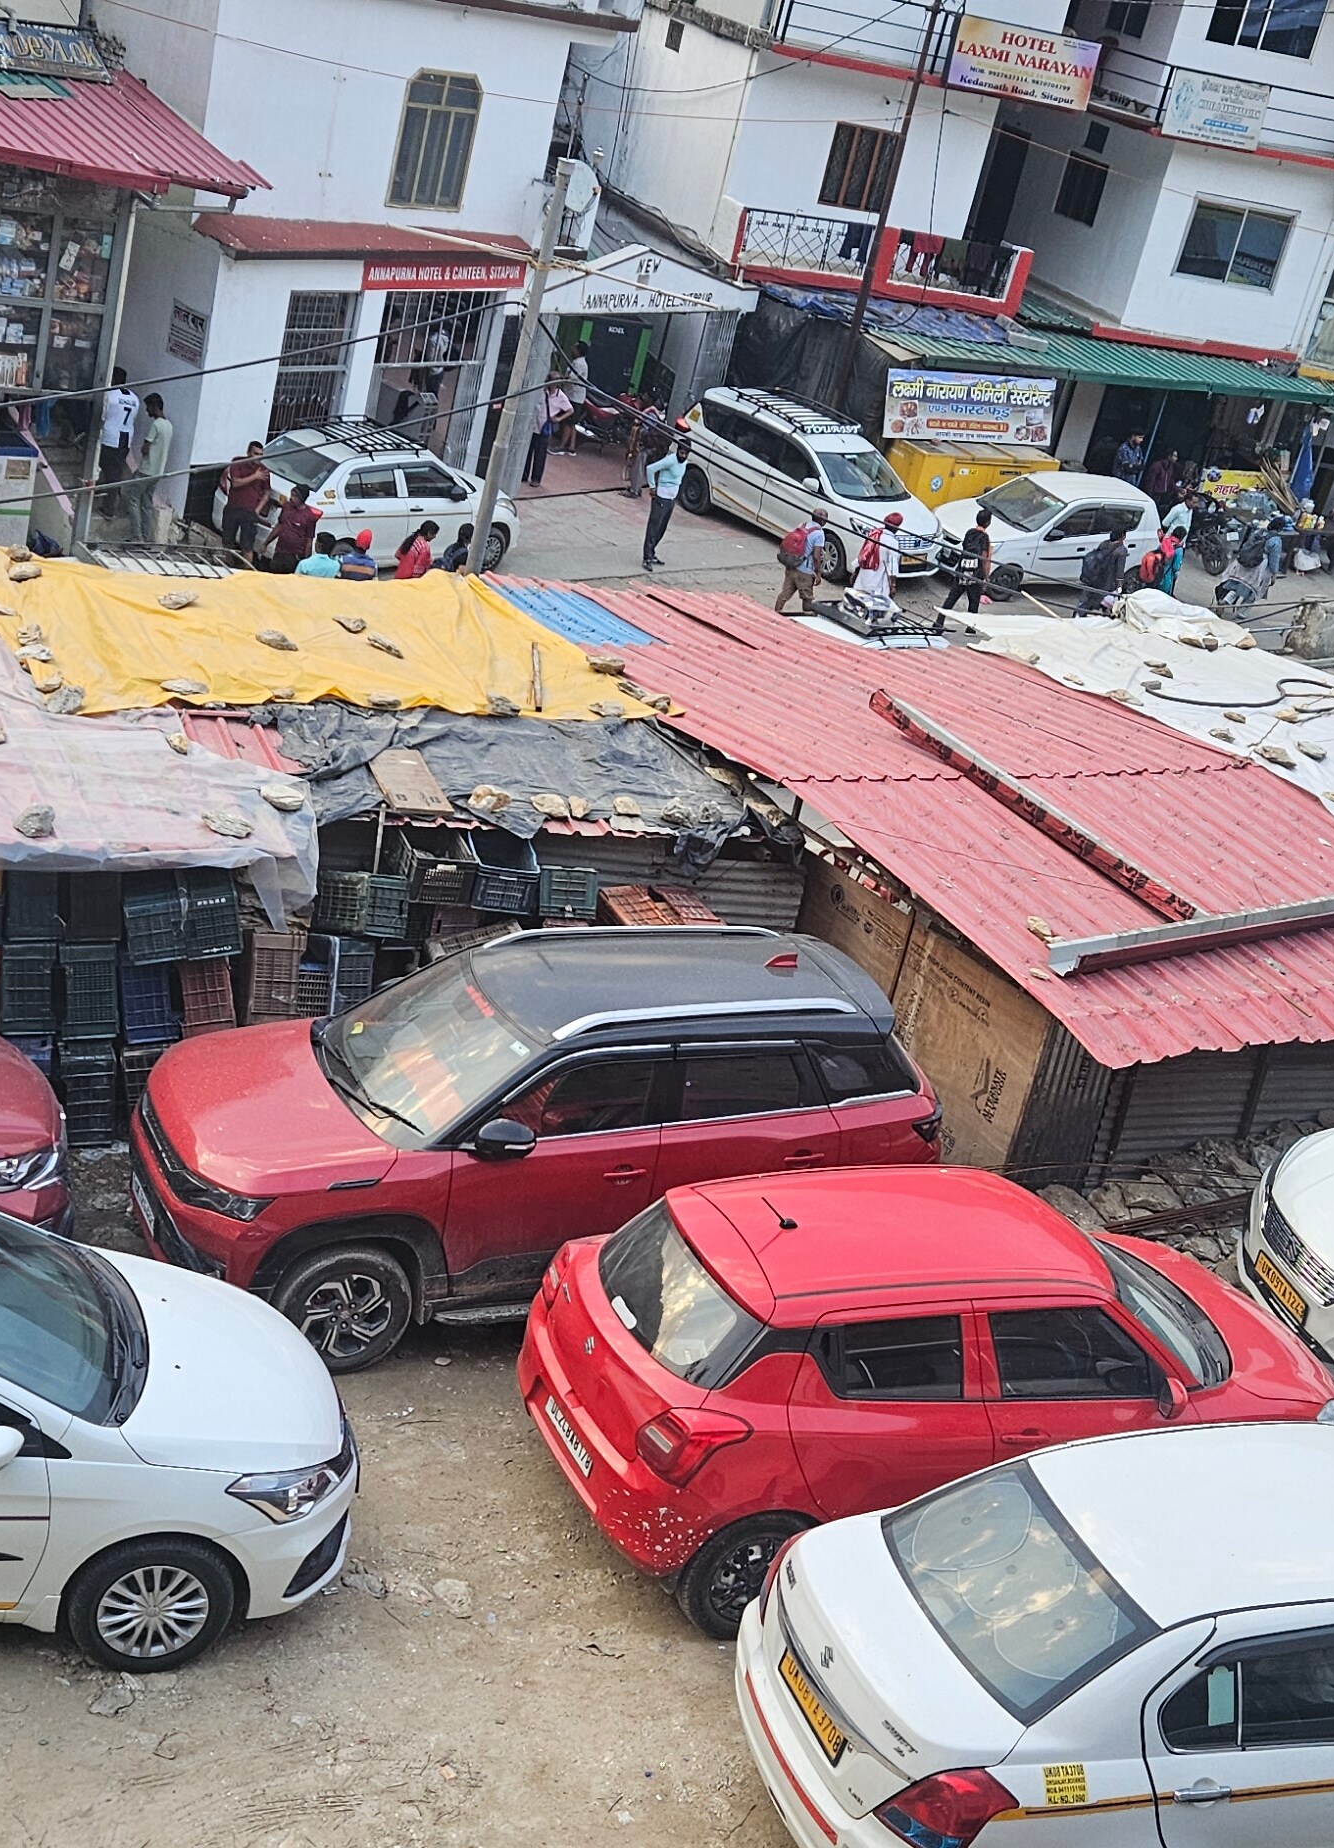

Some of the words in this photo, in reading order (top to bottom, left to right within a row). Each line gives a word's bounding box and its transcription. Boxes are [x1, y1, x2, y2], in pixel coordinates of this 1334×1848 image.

[1001, 31, 1056, 54] HOTEL
[957, 40, 1011, 63] LAXMI
[1014, 54, 1093, 80] NARAYAN
[959, 74, 1009, 93] Kedarnath
[1011, 86, 1038, 99] Road,
[1041, 91, 1075, 106] Sitapur
[368, 266, 416, 281] ANNAPURNA
[418, 266, 443, 280] HOTEL
[444, 266, 451, 280] &
[452, 266, 488, 281] CANTEEN,
[489, 265, 521, 279] SITAPUR
[636, 259, 663, 274] NEW
[585, 293, 640, 309] ANNAPURNA
[892, 374, 924, 399] लक्ष्मी
[926, 383, 968, 401] नारायण
[123, 407, 132, 426] 7
[928, 404, 948, 414] एण्ड
[950, 403, 985, 415] फास्ट
[988, 406, 1012, 421] फूड
[804, 424, 858, 434] TOURIST
[954, 974, 976, 996] CONTENT
[881, 1719, 919, 1755] SWIFT
